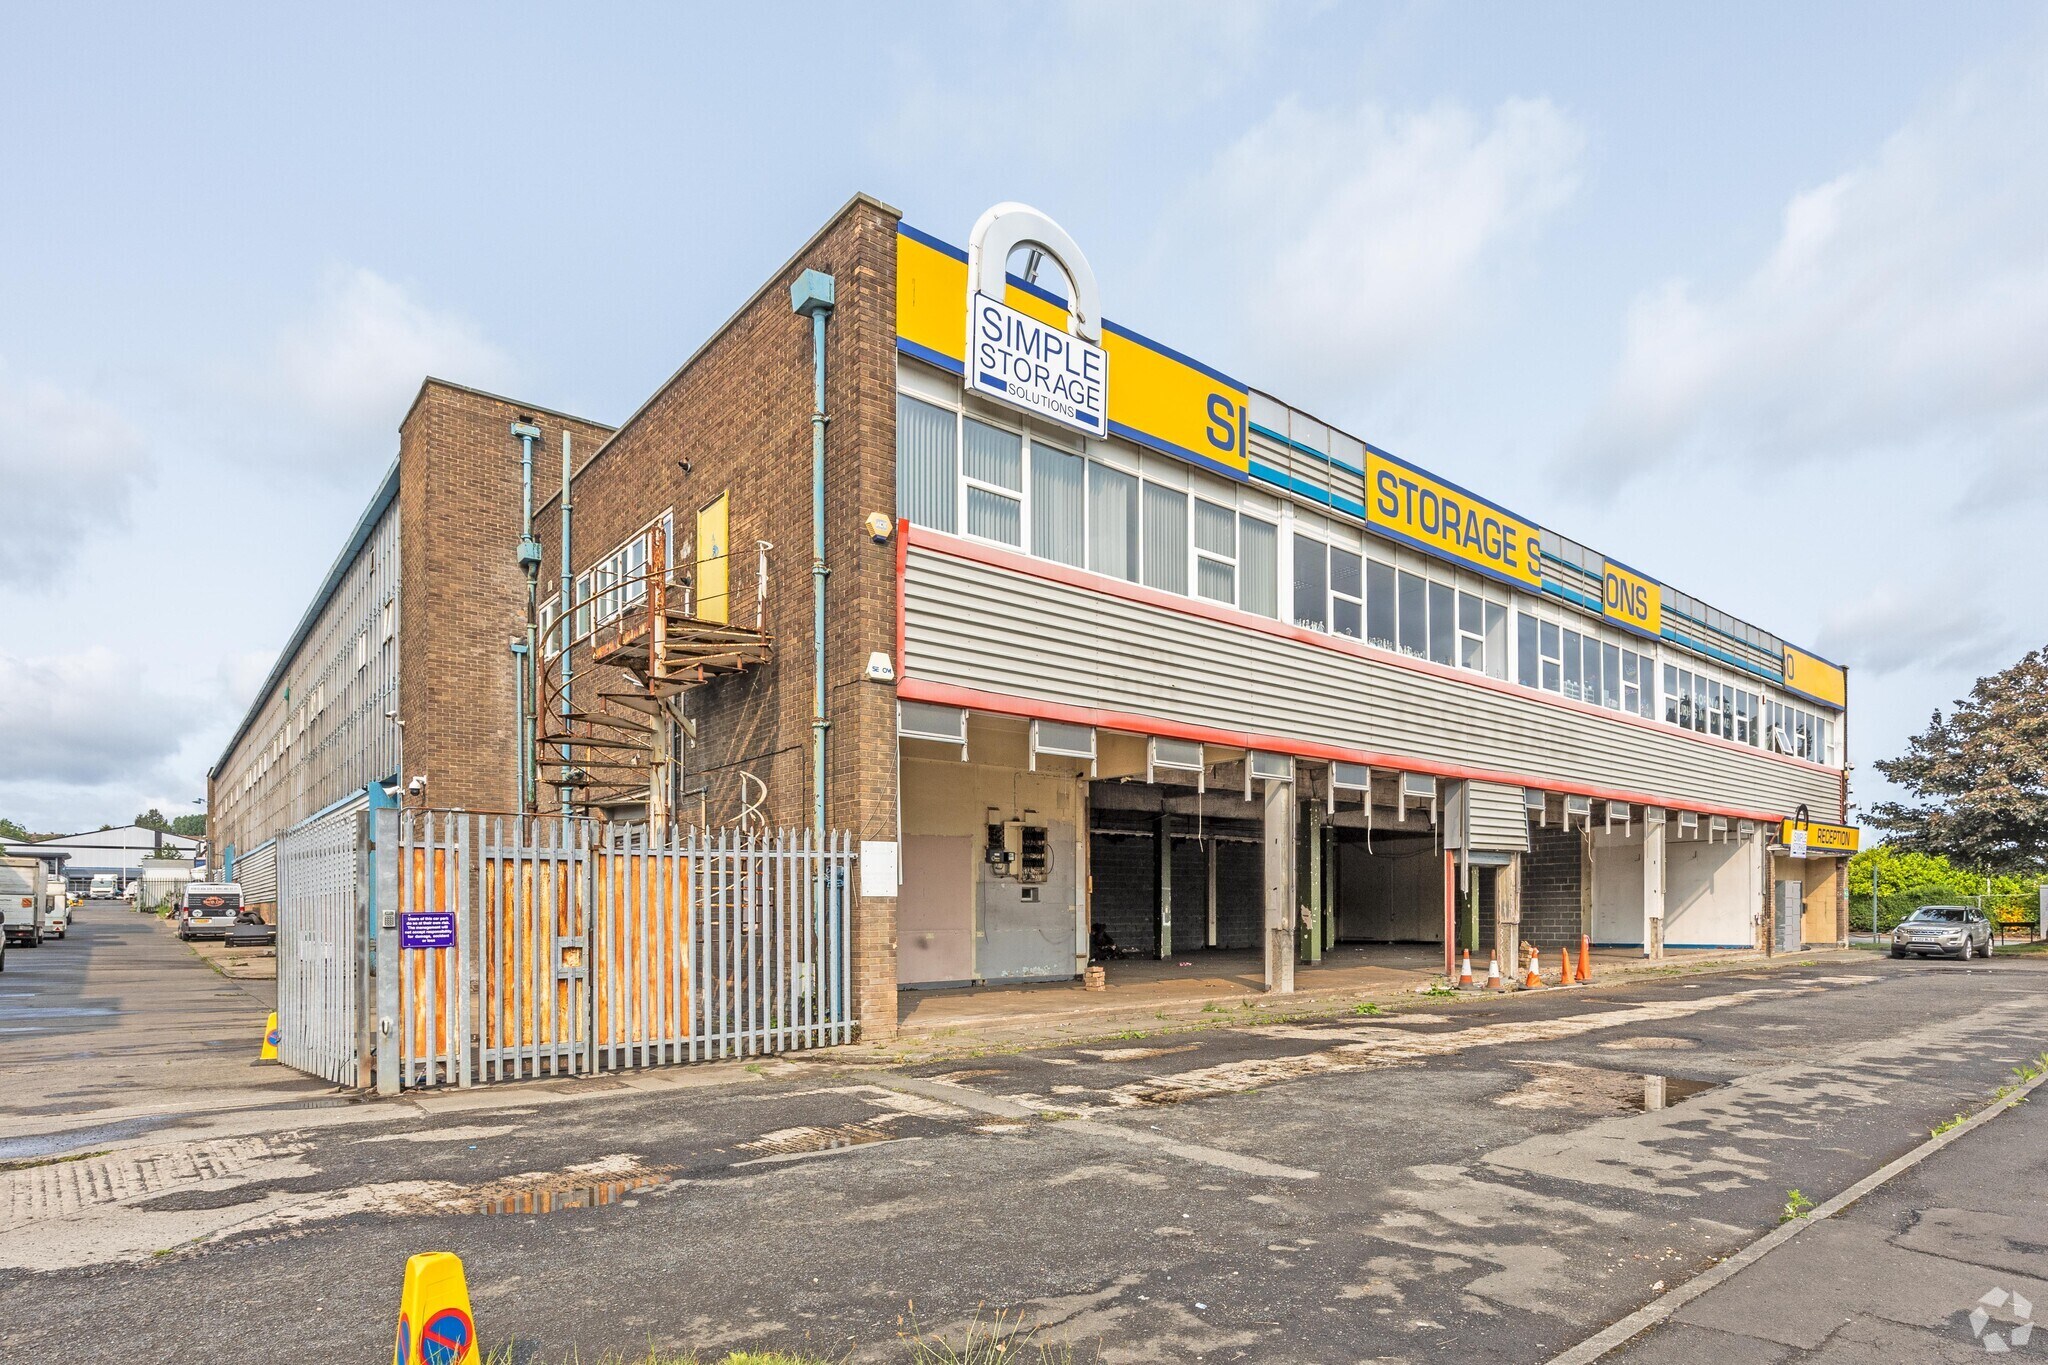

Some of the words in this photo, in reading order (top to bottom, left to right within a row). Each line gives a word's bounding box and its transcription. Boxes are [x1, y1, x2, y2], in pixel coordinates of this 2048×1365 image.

[979, 342, 1100, 412] STORAGE
[981, 306, 1100, 385] SIMPLE
[1008, 382, 1075, 419] SOLUTIONS
[1206, 392, 1246, 459] SI
[1376, 469, 1518, 568] STORAGE
[1605, 572, 1648, 621] ONS
[1817, 827, 1851, 847] RECEPTION
